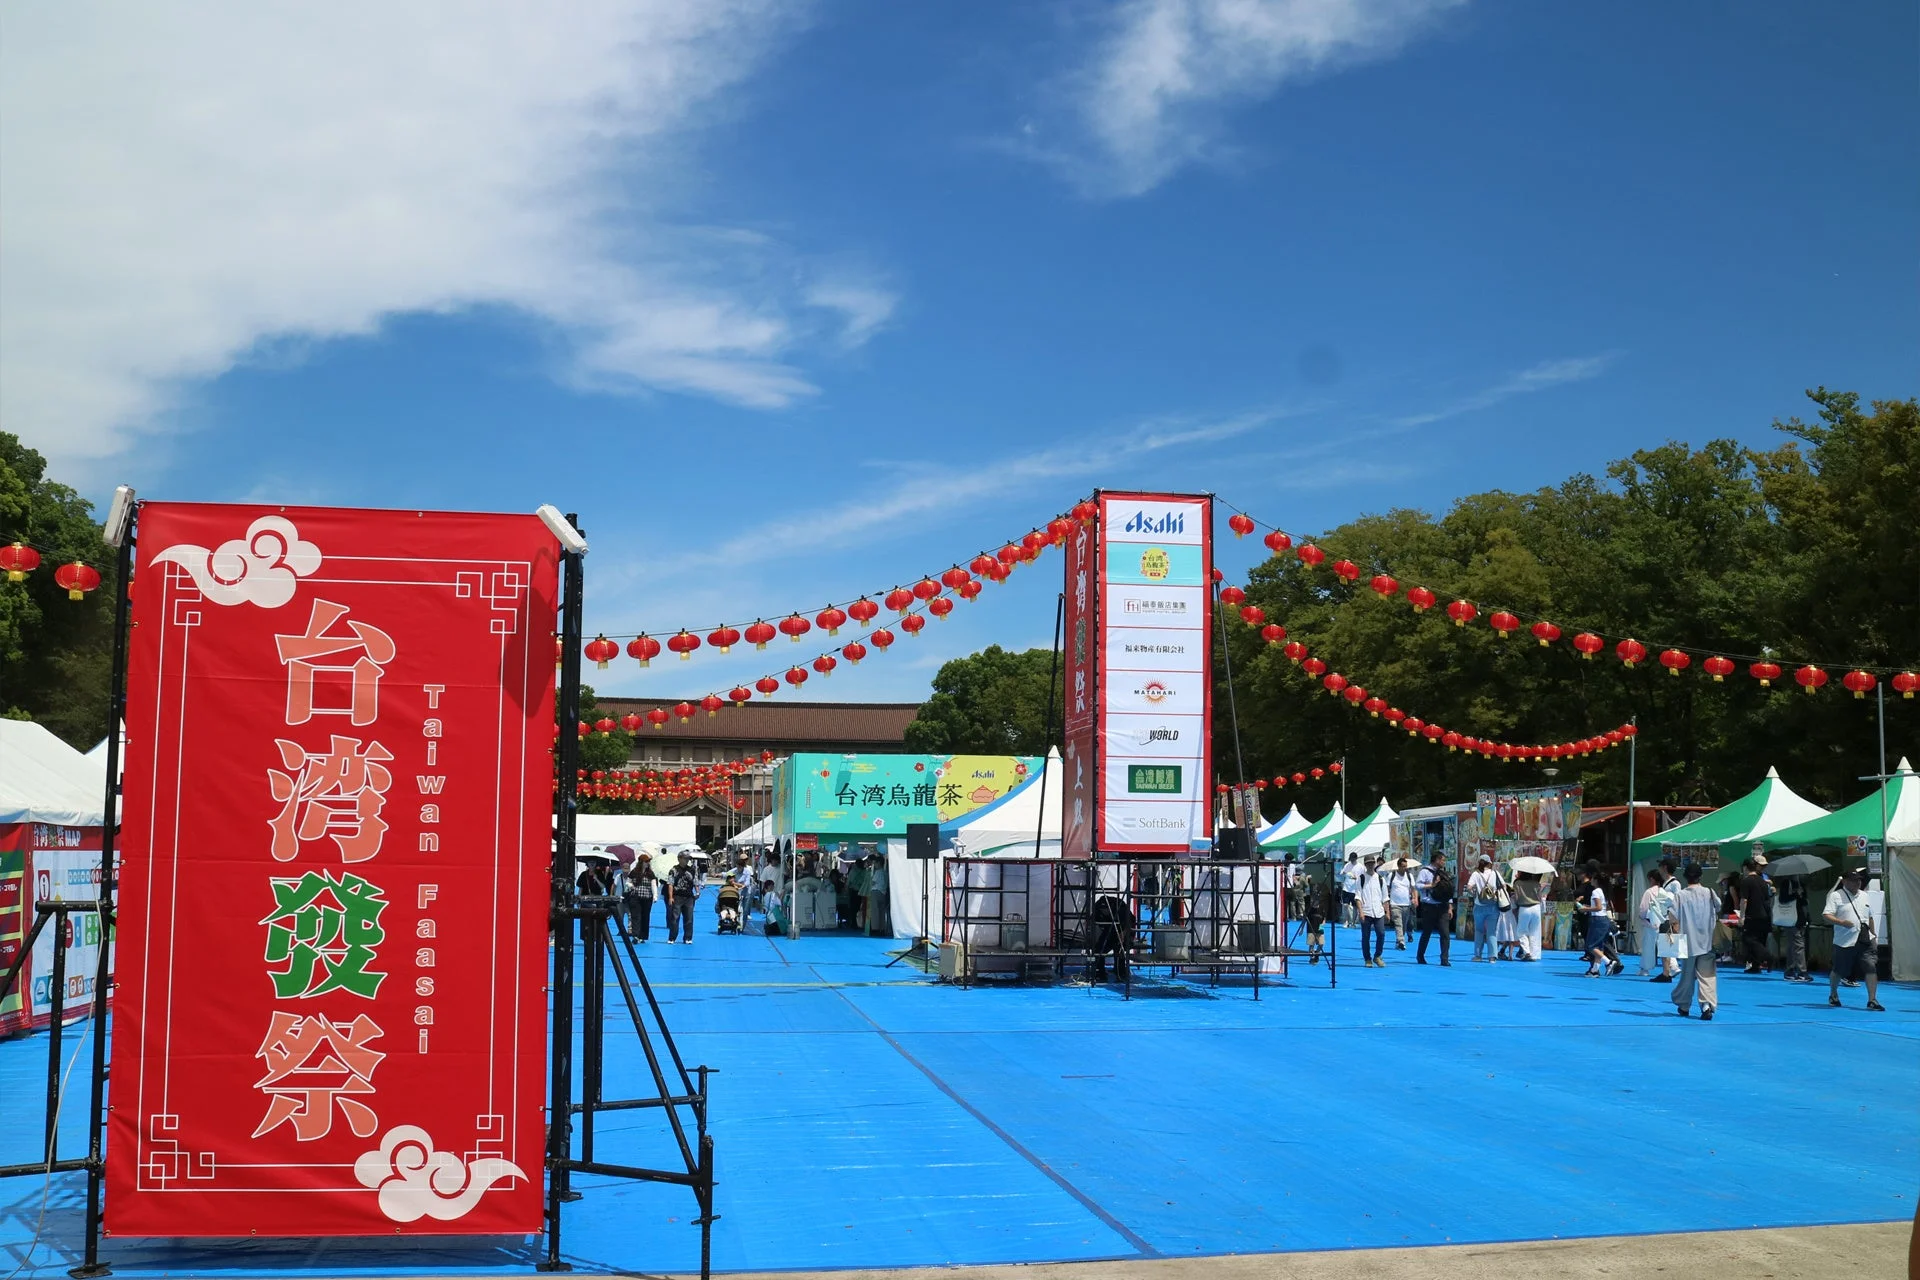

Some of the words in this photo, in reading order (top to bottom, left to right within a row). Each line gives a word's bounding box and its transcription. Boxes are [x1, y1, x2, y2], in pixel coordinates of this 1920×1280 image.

[1125, 511, 1184, 535] Asahi
[1125, 645, 1185, 653] 福来物産有限会社
[1149, 729, 1179, 741] WORLD
[416, 684, 446, 852] Taiwan
[971, 769, 995, 779] Asahi
[834, 783, 963, 808] 台湾烏龍茶
[1139, 817, 1186, 829] SoftBank
[414, 884, 439, 1054] Faasai
